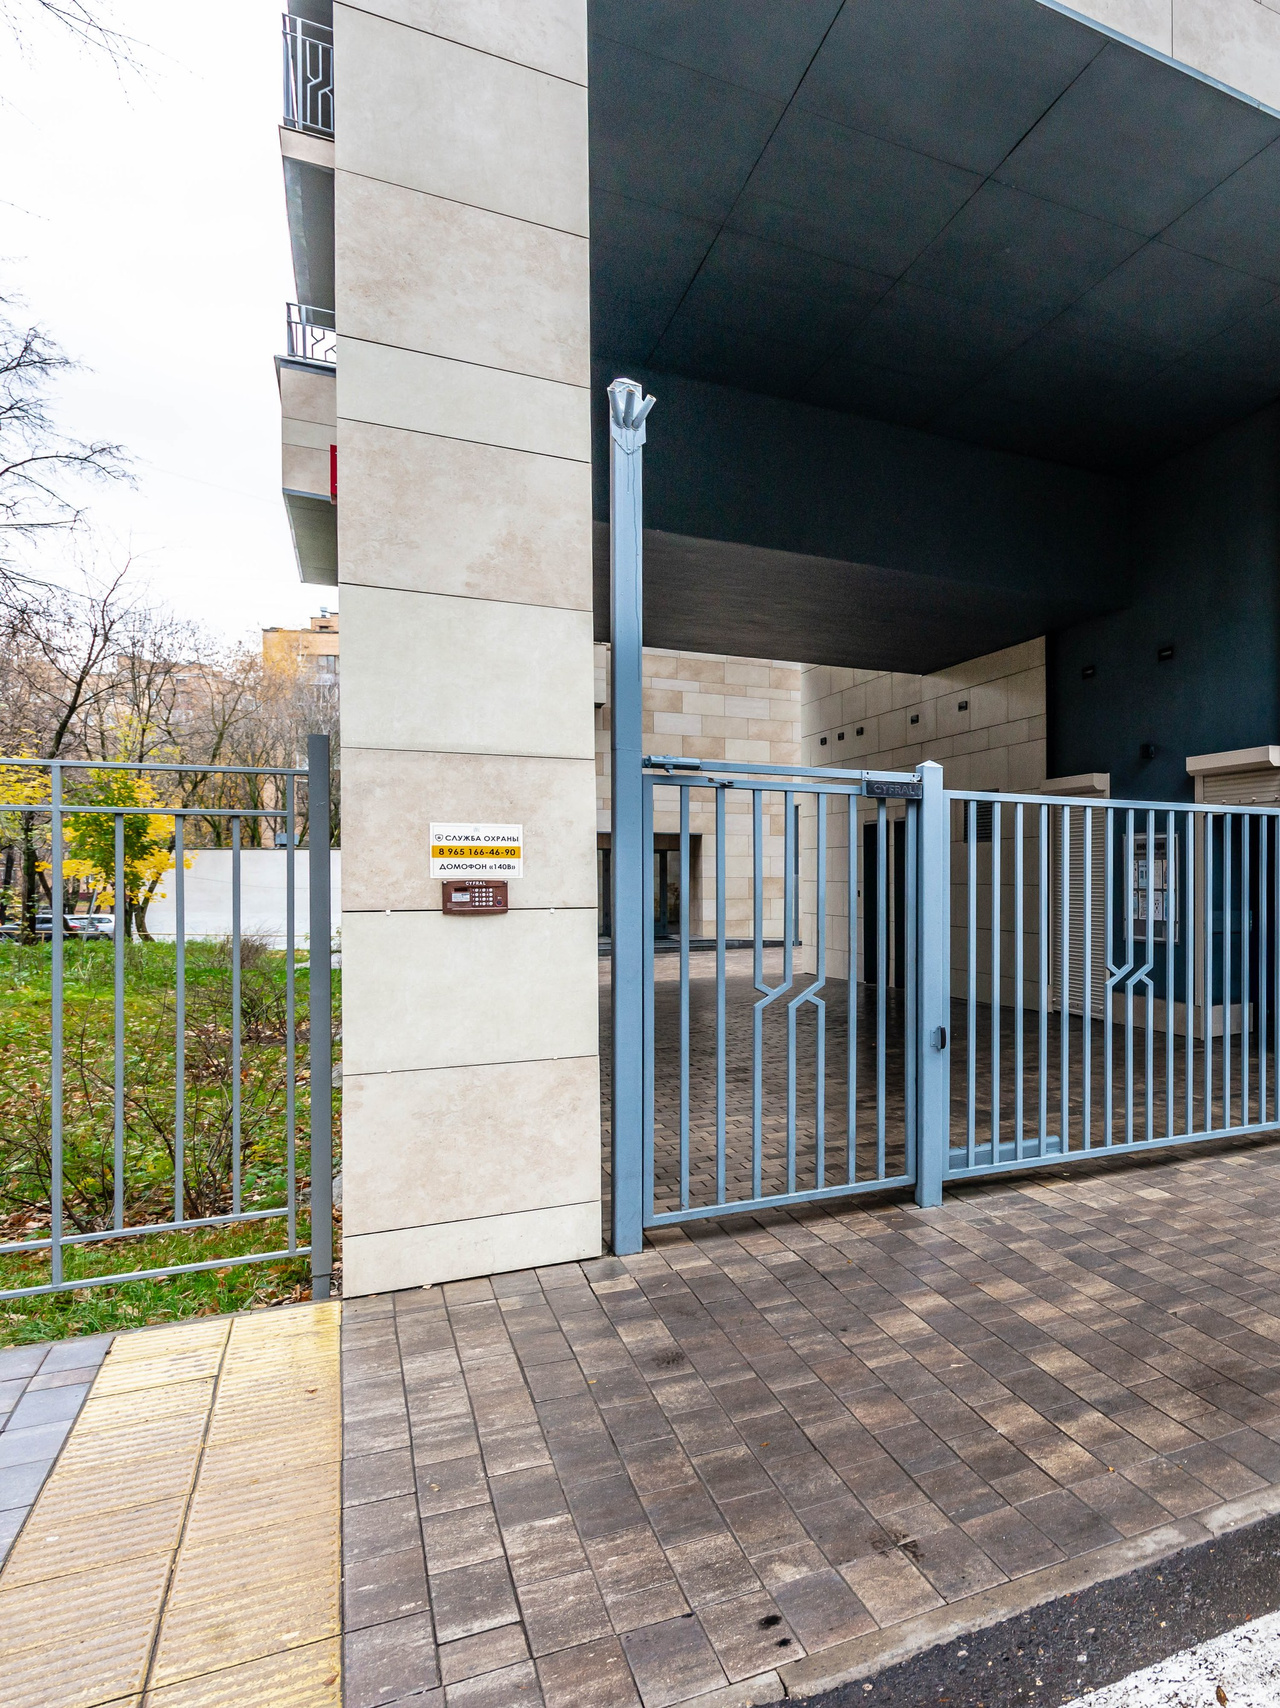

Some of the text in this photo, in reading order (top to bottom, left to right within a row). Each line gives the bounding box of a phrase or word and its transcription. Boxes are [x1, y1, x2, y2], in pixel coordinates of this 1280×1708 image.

[873, 784, 915, 795] CYFRAL
[445, 834, 482, 842] СЛУЖБА
[438, 848, 516, 856] 8 965 166-46-90
